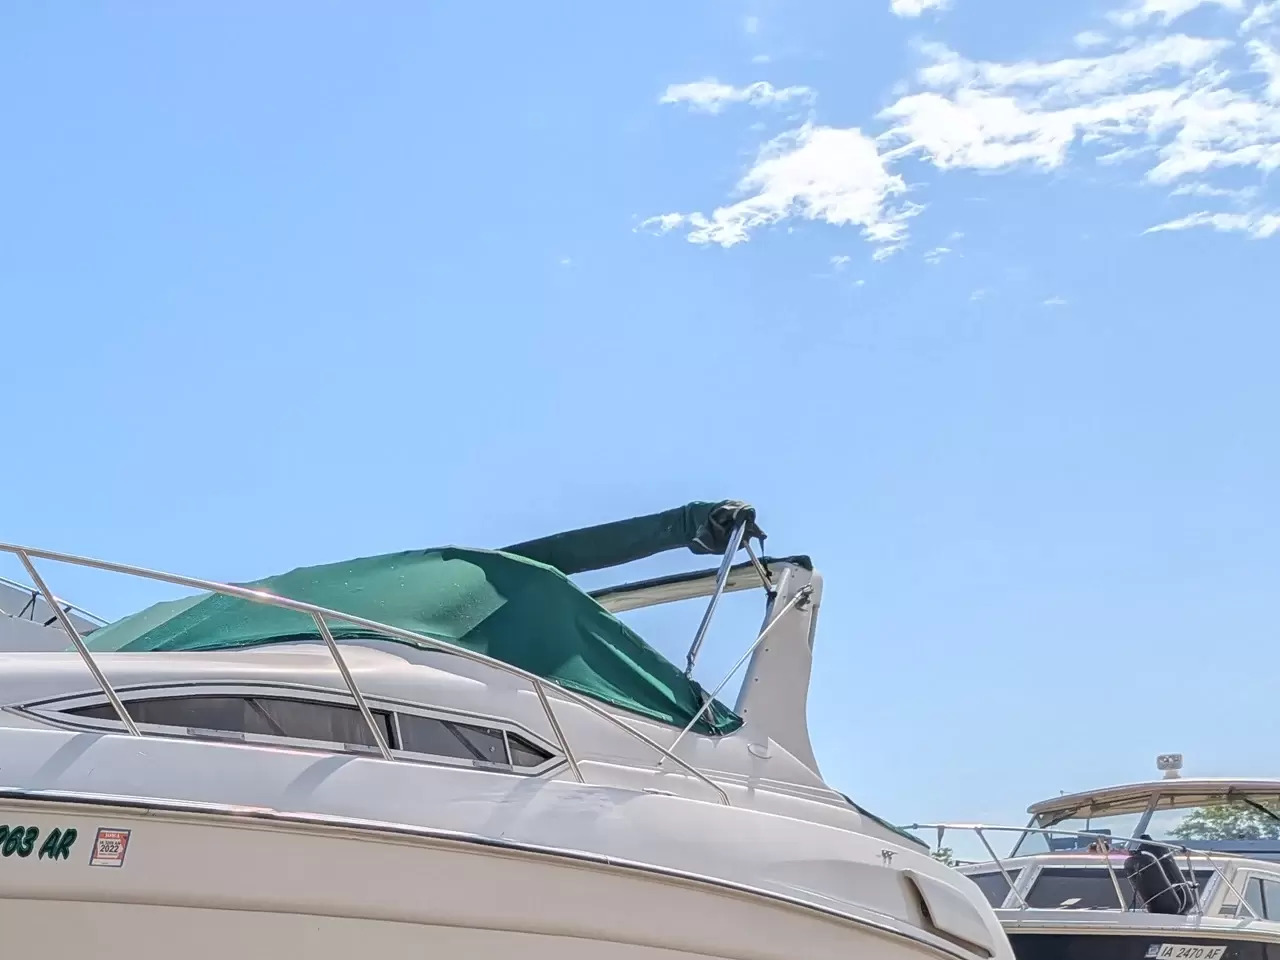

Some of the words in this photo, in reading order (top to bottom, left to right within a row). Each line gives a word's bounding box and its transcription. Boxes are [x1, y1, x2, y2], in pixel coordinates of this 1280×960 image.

[38, 827, 78, 860] AR
[100, 844, 120, 853] 2022
[1161, 946, 1173, 957] IA
[1176, 947, 1203, 959] 2470
[1204, 948, 1221, 959] AF
